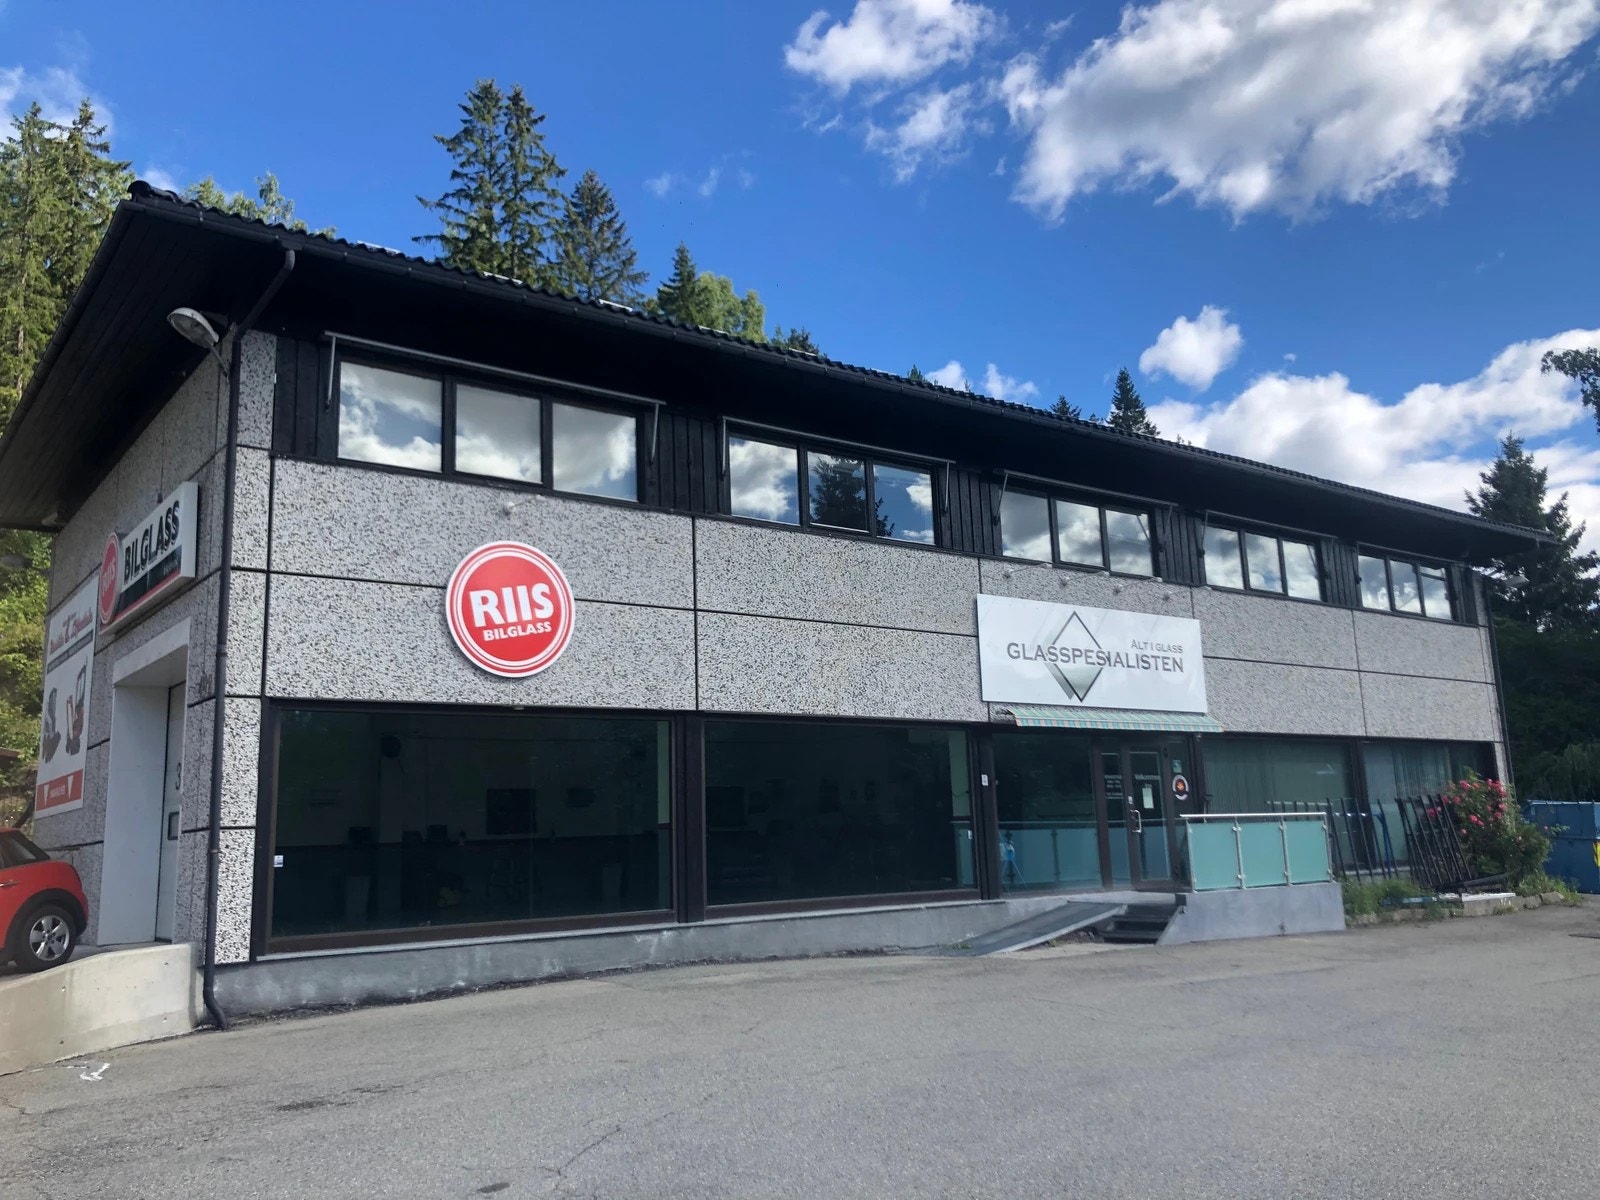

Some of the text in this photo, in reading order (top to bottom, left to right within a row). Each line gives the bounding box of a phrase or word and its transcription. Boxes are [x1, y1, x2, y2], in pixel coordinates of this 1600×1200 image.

[123, 500, 180, 585] BILGLASS
[469, 582, 555, 628] RIIS
[482, 621, 552, 641] BILGLASS
[1131, 639, 1148, 650] ALT
[1155, 643, 1183, 653] GLASS
[1006, 642, 1184, 673] GLASSPESIALISTEN
